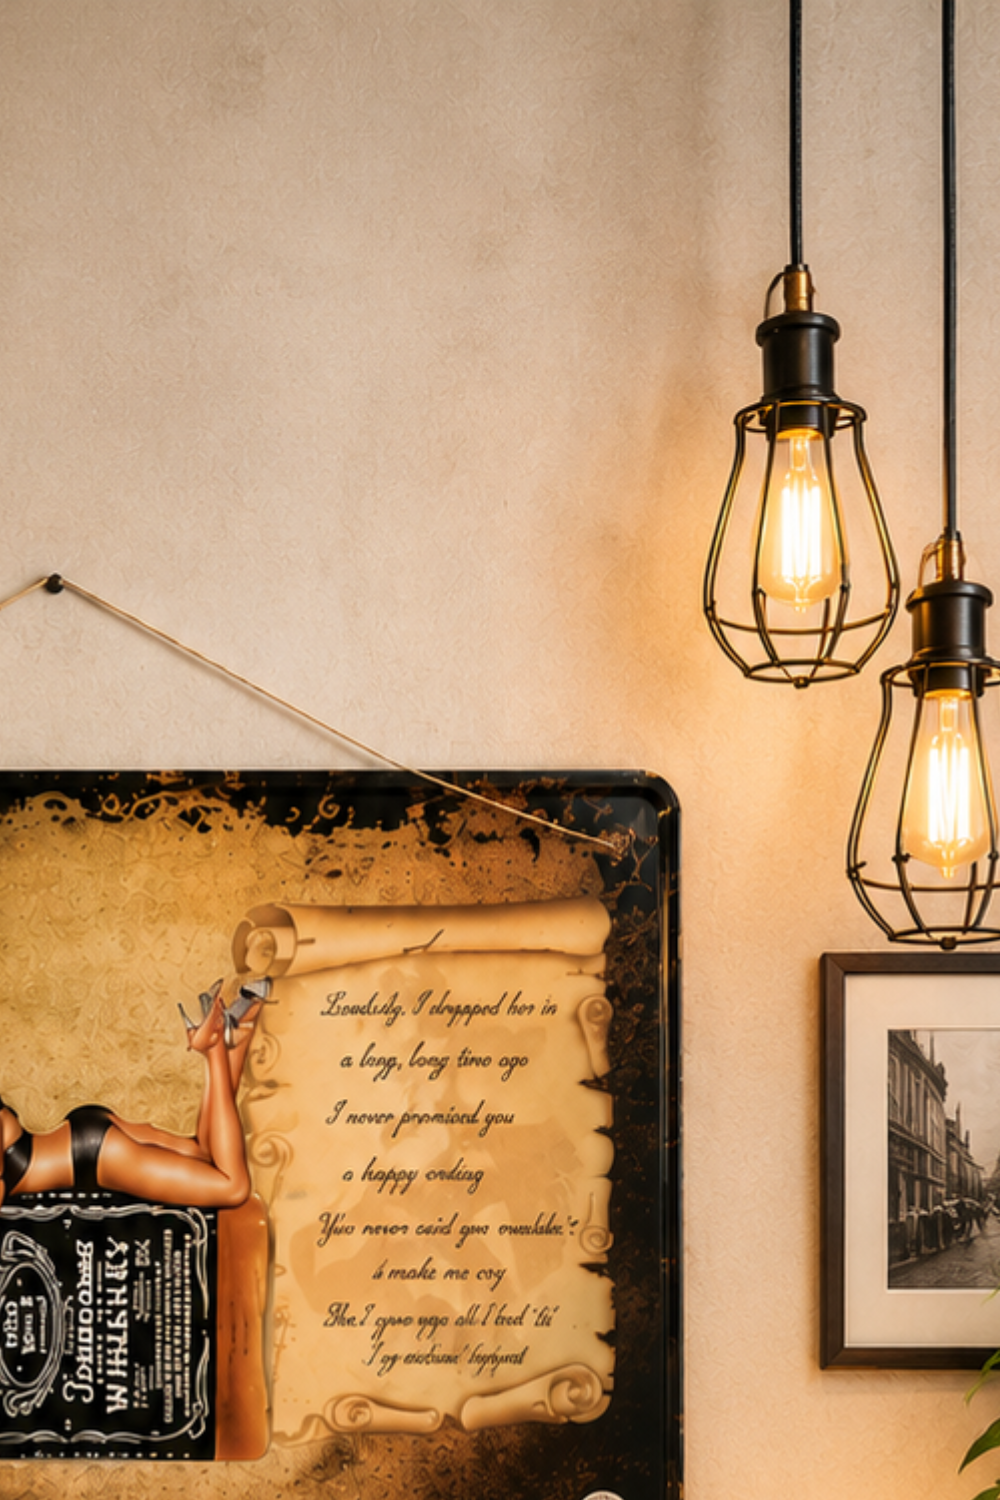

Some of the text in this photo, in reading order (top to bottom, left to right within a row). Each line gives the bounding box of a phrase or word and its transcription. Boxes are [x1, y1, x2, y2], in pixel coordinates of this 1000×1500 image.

[340, 1055, 353, 1068] a
[325, 1099, 348, 1125] I
[478, 1112, 515, 1138] you
[361, 1156, 419, 1195] happy
[443, 1268, 470, 1280] me
